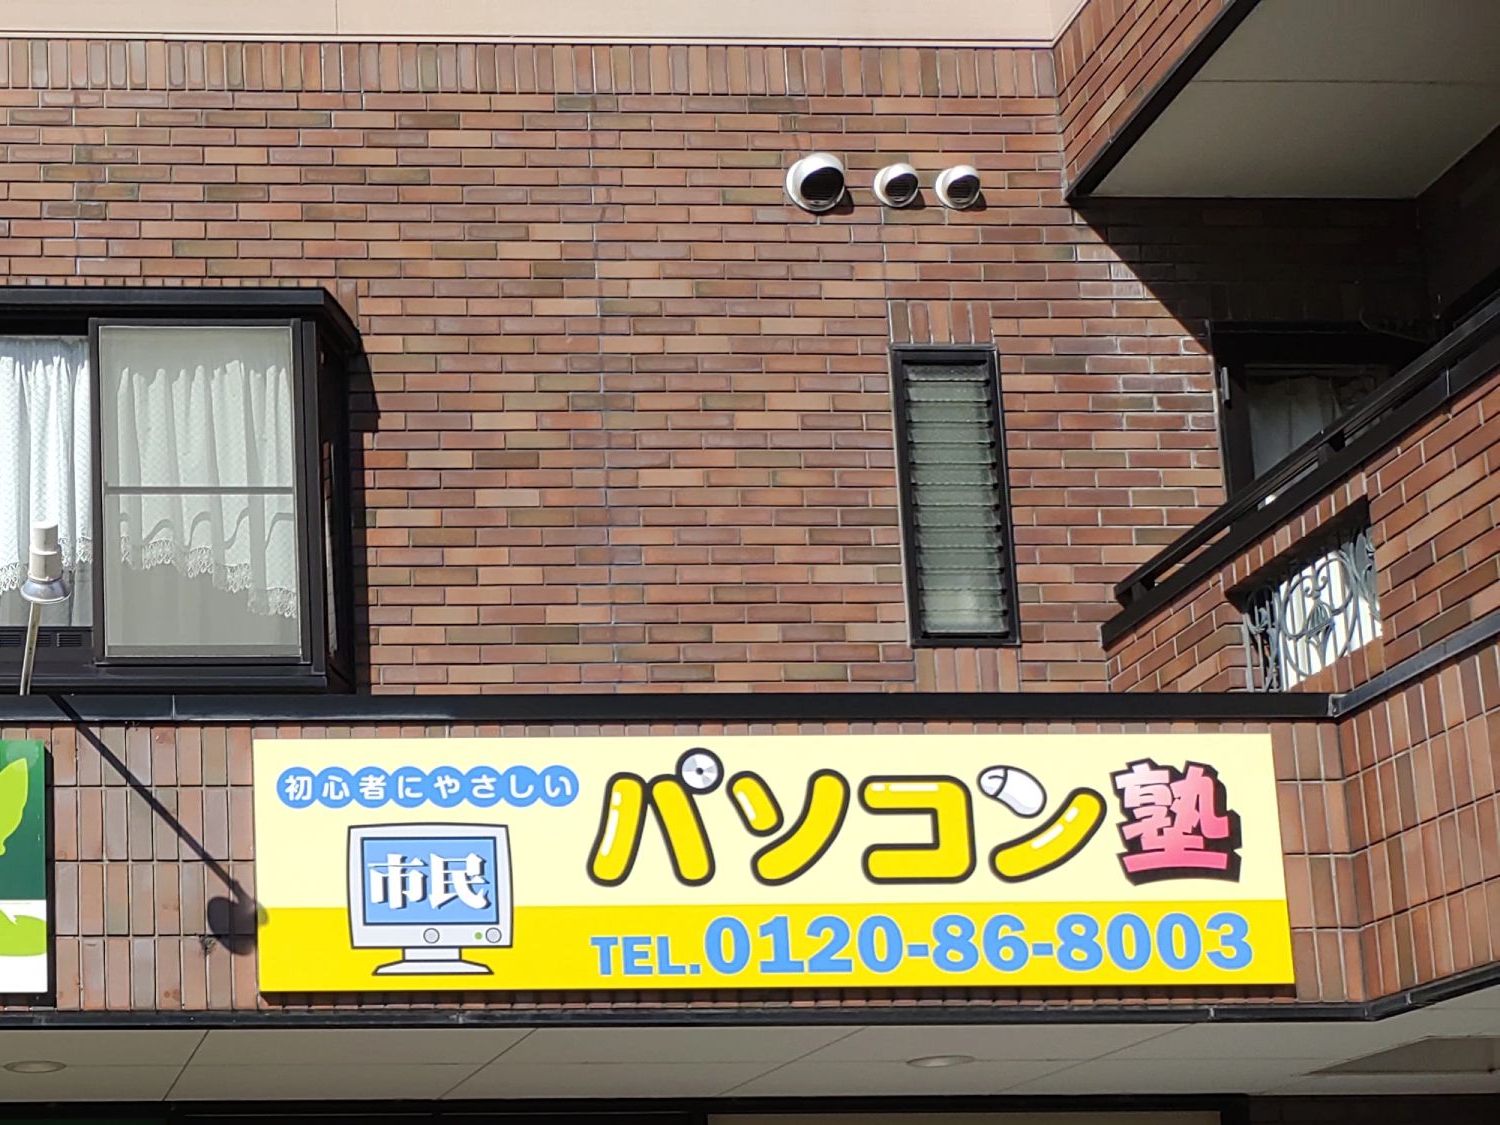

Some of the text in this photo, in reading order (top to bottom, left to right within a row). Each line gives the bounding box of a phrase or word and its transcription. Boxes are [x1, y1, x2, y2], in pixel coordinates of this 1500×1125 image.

[284, 773, 573, 803] 初心者にやさしい
[587, 747, 1243, 887] パソコン塾
[367, 852, 491, 911] 市民
